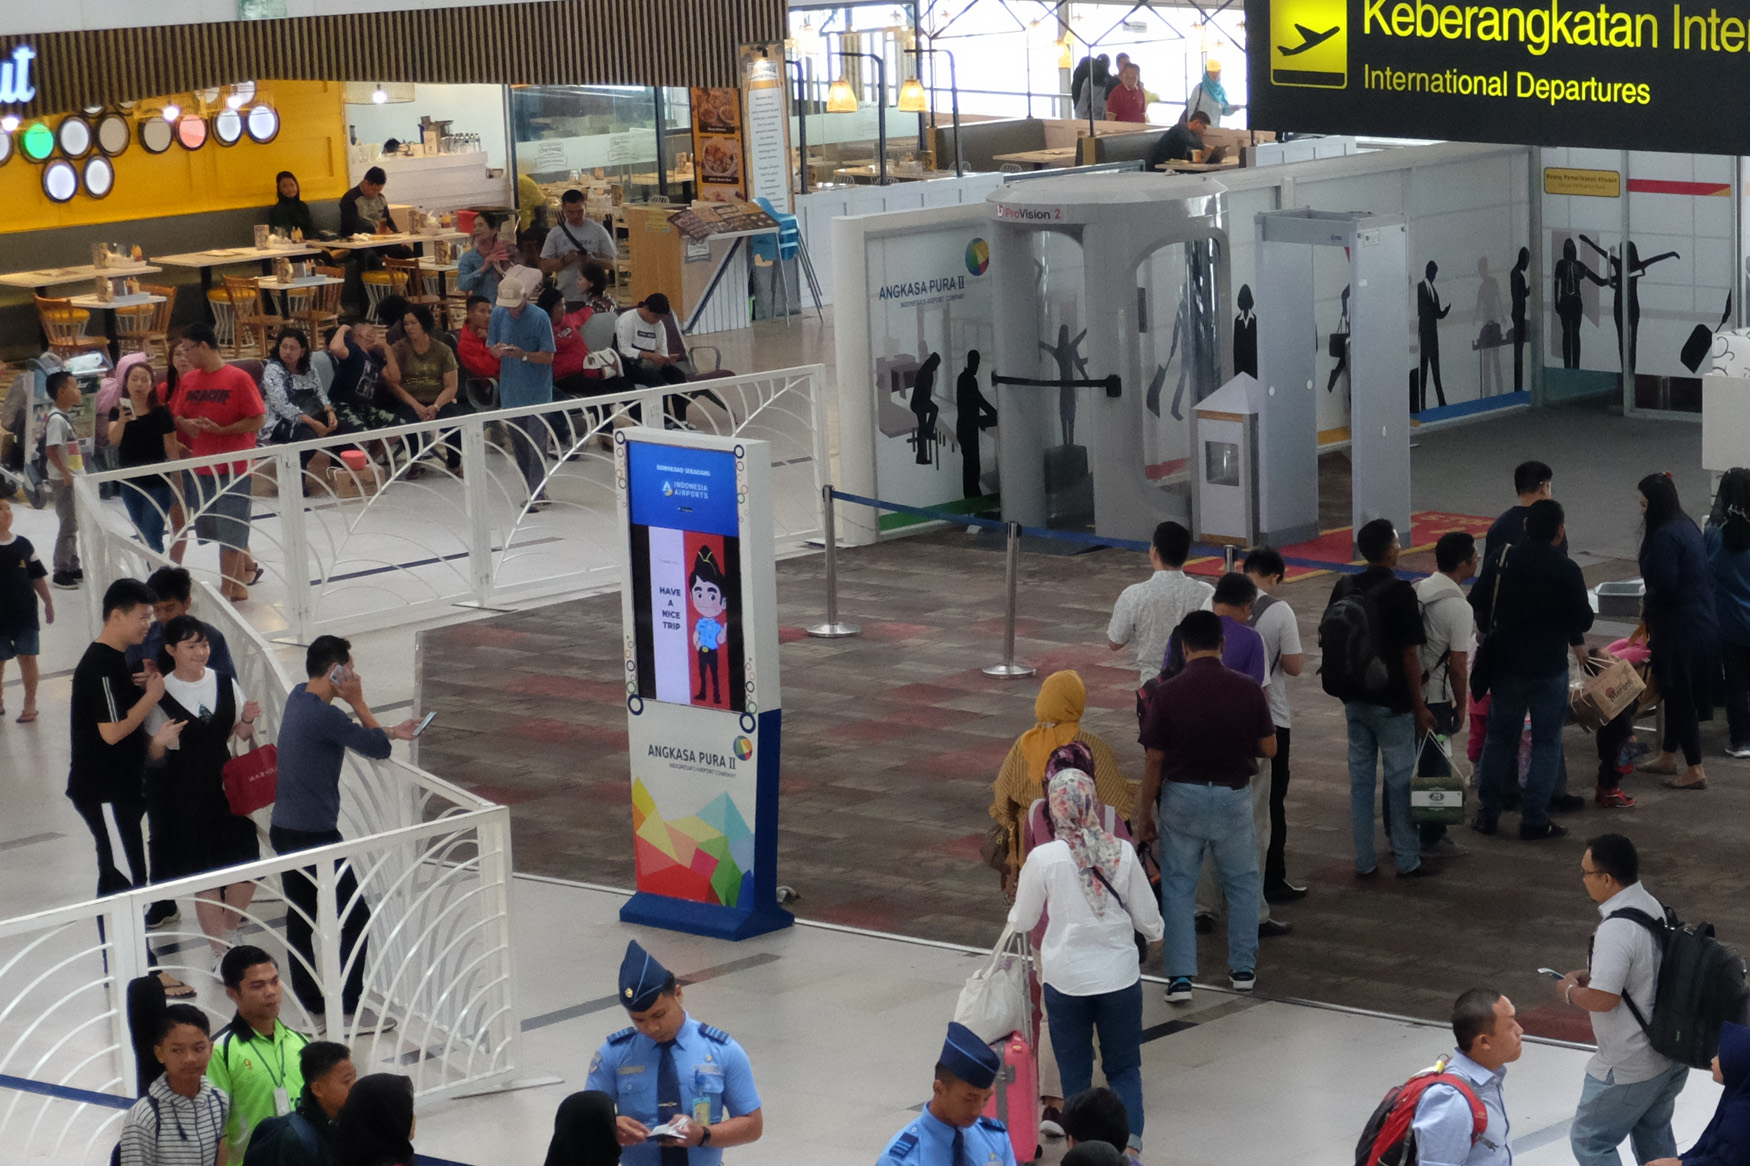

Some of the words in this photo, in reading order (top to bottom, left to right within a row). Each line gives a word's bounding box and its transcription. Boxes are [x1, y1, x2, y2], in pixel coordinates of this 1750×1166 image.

[1364, 0, 1658, 55] Keberangkatan
[1364, 64, 1508, 97] International
[1516, 71, 1650, 106] Departures
[1005, 207, 1051, 220] ProVision
[1054, 207, 1061, 220] 2
[879, 281, 928, 300] ANGKASA
[929, 277, 957, 293] PURA
[673, 481, 708, 491] INDONESIA
[674, 489, 709, 499] AIRPORTS
[659, 586, 681, 597] HAVE
[667, 599, 674, 607] A
[662, 609, 681, 620] NICE
[662, 621, 681, 631] TRIP
[648, 744, 696, 763] ANGKASA
[699, 751, 726, 769] PURA
[728, 756, 736, 770] II
